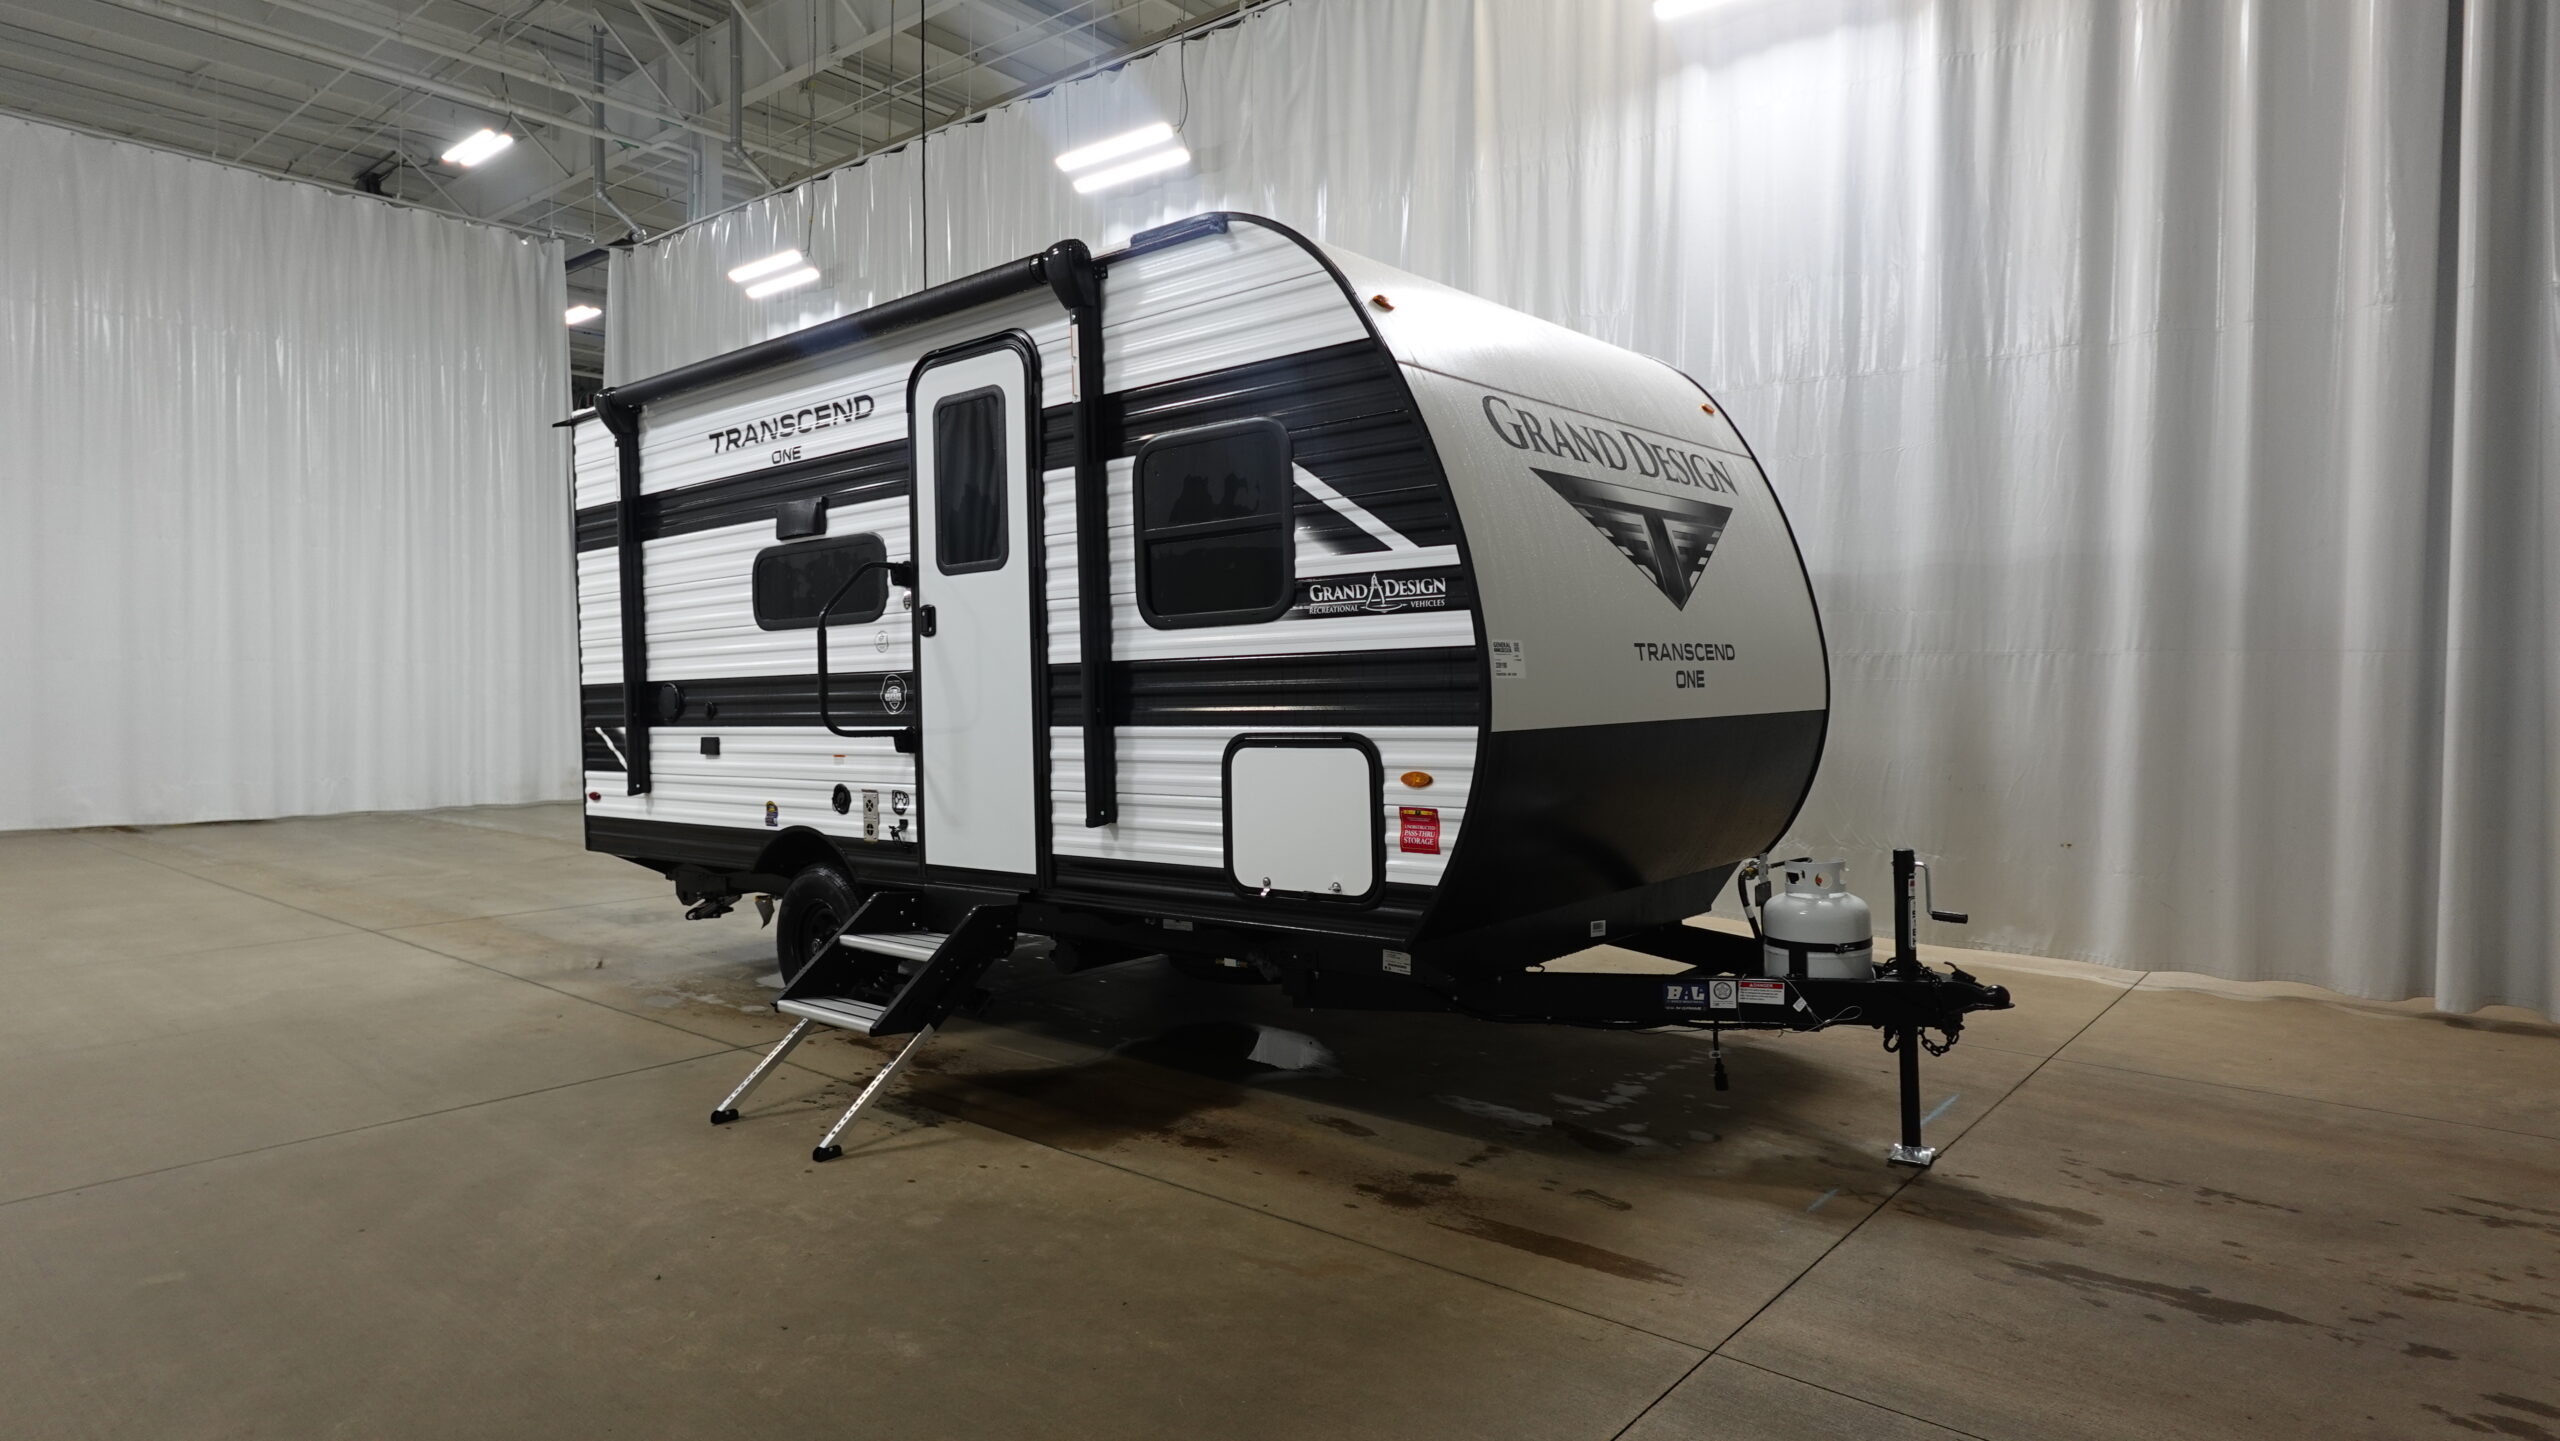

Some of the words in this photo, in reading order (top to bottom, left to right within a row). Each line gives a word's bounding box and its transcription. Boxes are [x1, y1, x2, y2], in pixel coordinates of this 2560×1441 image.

[708, 394, 875, 454] TRANSCEND
[1482, 395, 1628, 471] GRAND
[1617, 429, 1739, 496] DESIGN
[771, 446, 802, 465] ONE
[1309, 584, 1368, 602] GRAND
[1382, 577, 1447, 597] DESIGN
[1309, 604, 1359, 615] RECREATIONAL
[1410, 599, 1446, 609] VEHICLES
[1634, 642, 1736, 662] TRANSCEND
[1675, 670, 1706, 689] ONE
[1403, 837, 1434, 845] STORAGE
[1404, 830, 1436, 838] PASS-THRU
